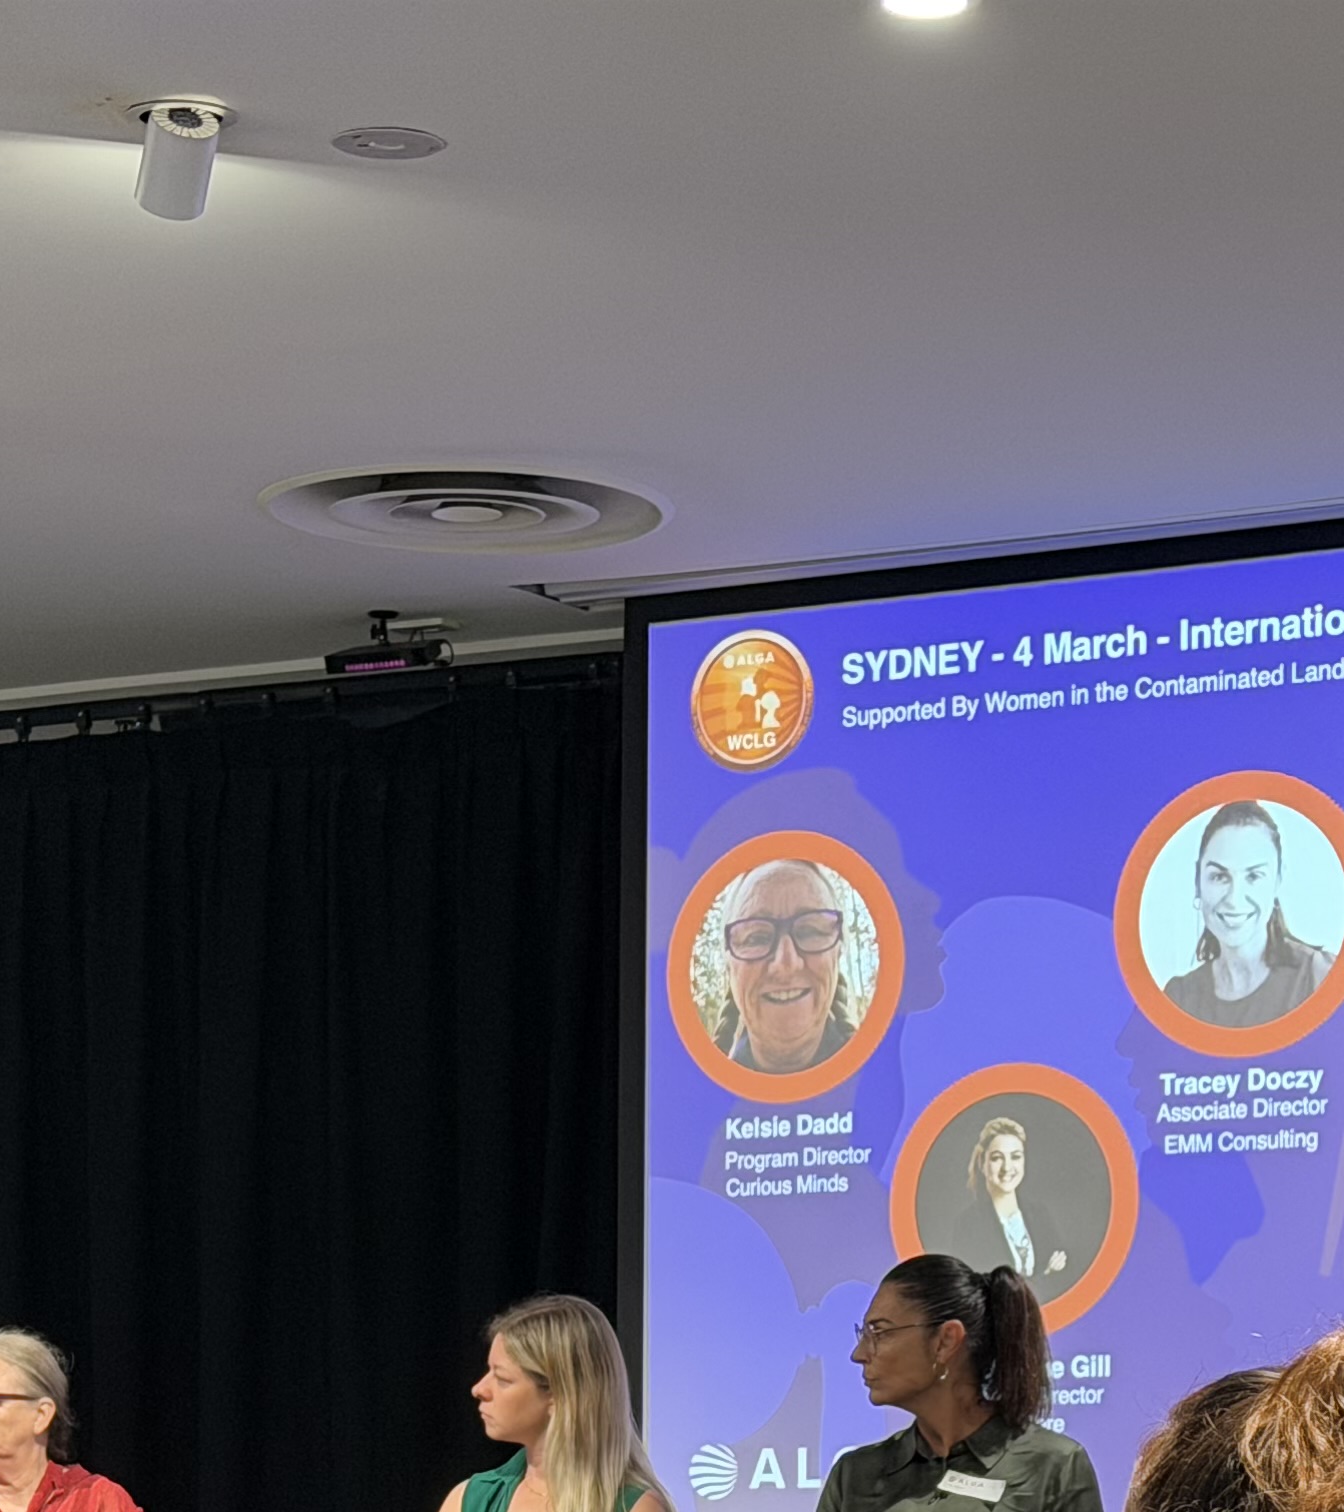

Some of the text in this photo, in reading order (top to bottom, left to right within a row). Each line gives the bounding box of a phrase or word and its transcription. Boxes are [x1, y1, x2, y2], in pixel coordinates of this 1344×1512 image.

[736, 651, 776, 667] ALGA
[841, 639, 984, 685] SYDNEY
[991, 652, 1005, 662] -
[1012, 636, 1034, 667] 4
[1043, 625, 1147, 665] March
[1156, 635, 1170, 645] -
[841, 698, 946, 730] Supported
[952, 694, 979, 721] By
[984, 688, 1064, 714] Women
[1071, 683, 1089, 706] in
[1094, 680, 1129, 703] the
[1134, 662, 1285, 699] Contaminated
[727, 731, 777, 751] WCLG
[1159, 1067, 1324, 1099] Tracey Doczy
[1156, 1096, 1329, 1124] Associate Director
[725, 1110, 853, 1140] Kelsie Dadd
[1164, 1128, 1319, 1155] EMM Consulting
[724, 1146, 873, 1173] Program Director
[725, 1172, 849, 1198] Curious Minds
[1070, 1353, 1111, 1379] Gill
[1051, 1385, 1105, 1405] rector
[748, 1445, 854, 1490] AL
